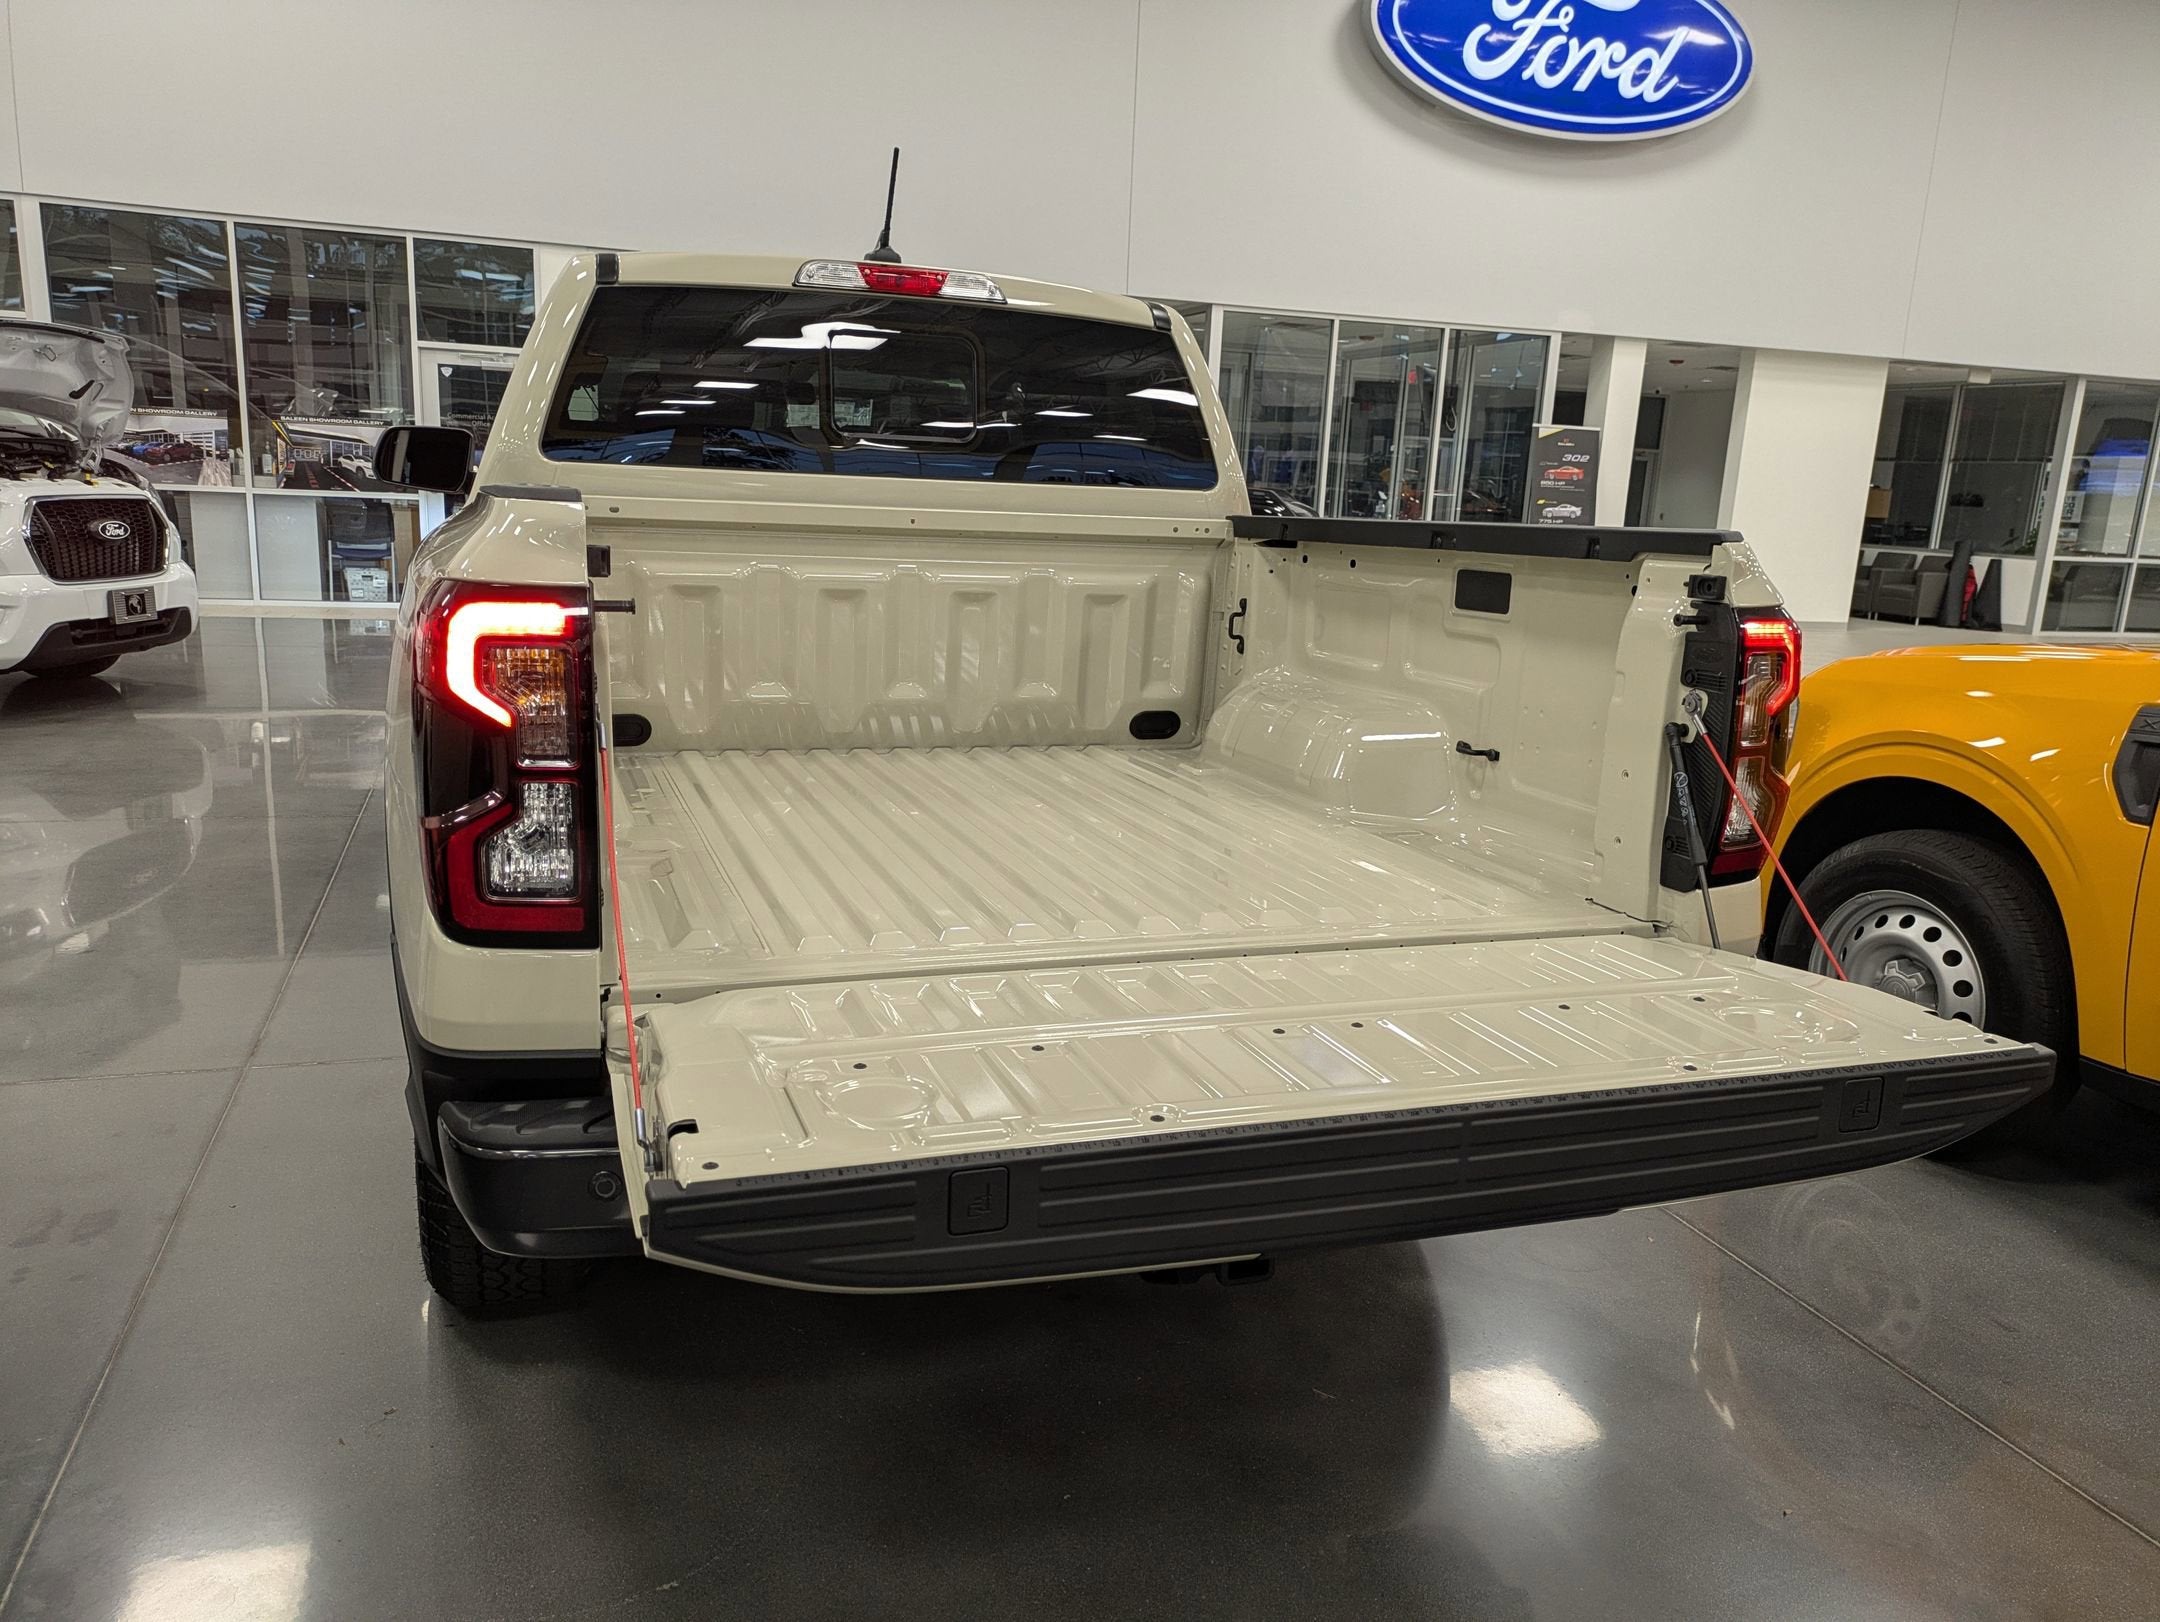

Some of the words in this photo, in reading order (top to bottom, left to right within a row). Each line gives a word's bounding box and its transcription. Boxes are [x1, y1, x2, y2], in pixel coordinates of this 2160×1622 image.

[1461, 0, 1691, 104] Ford
[1562, 453, 1590, 463] 302
[105, 523, 125, 536] Ford
